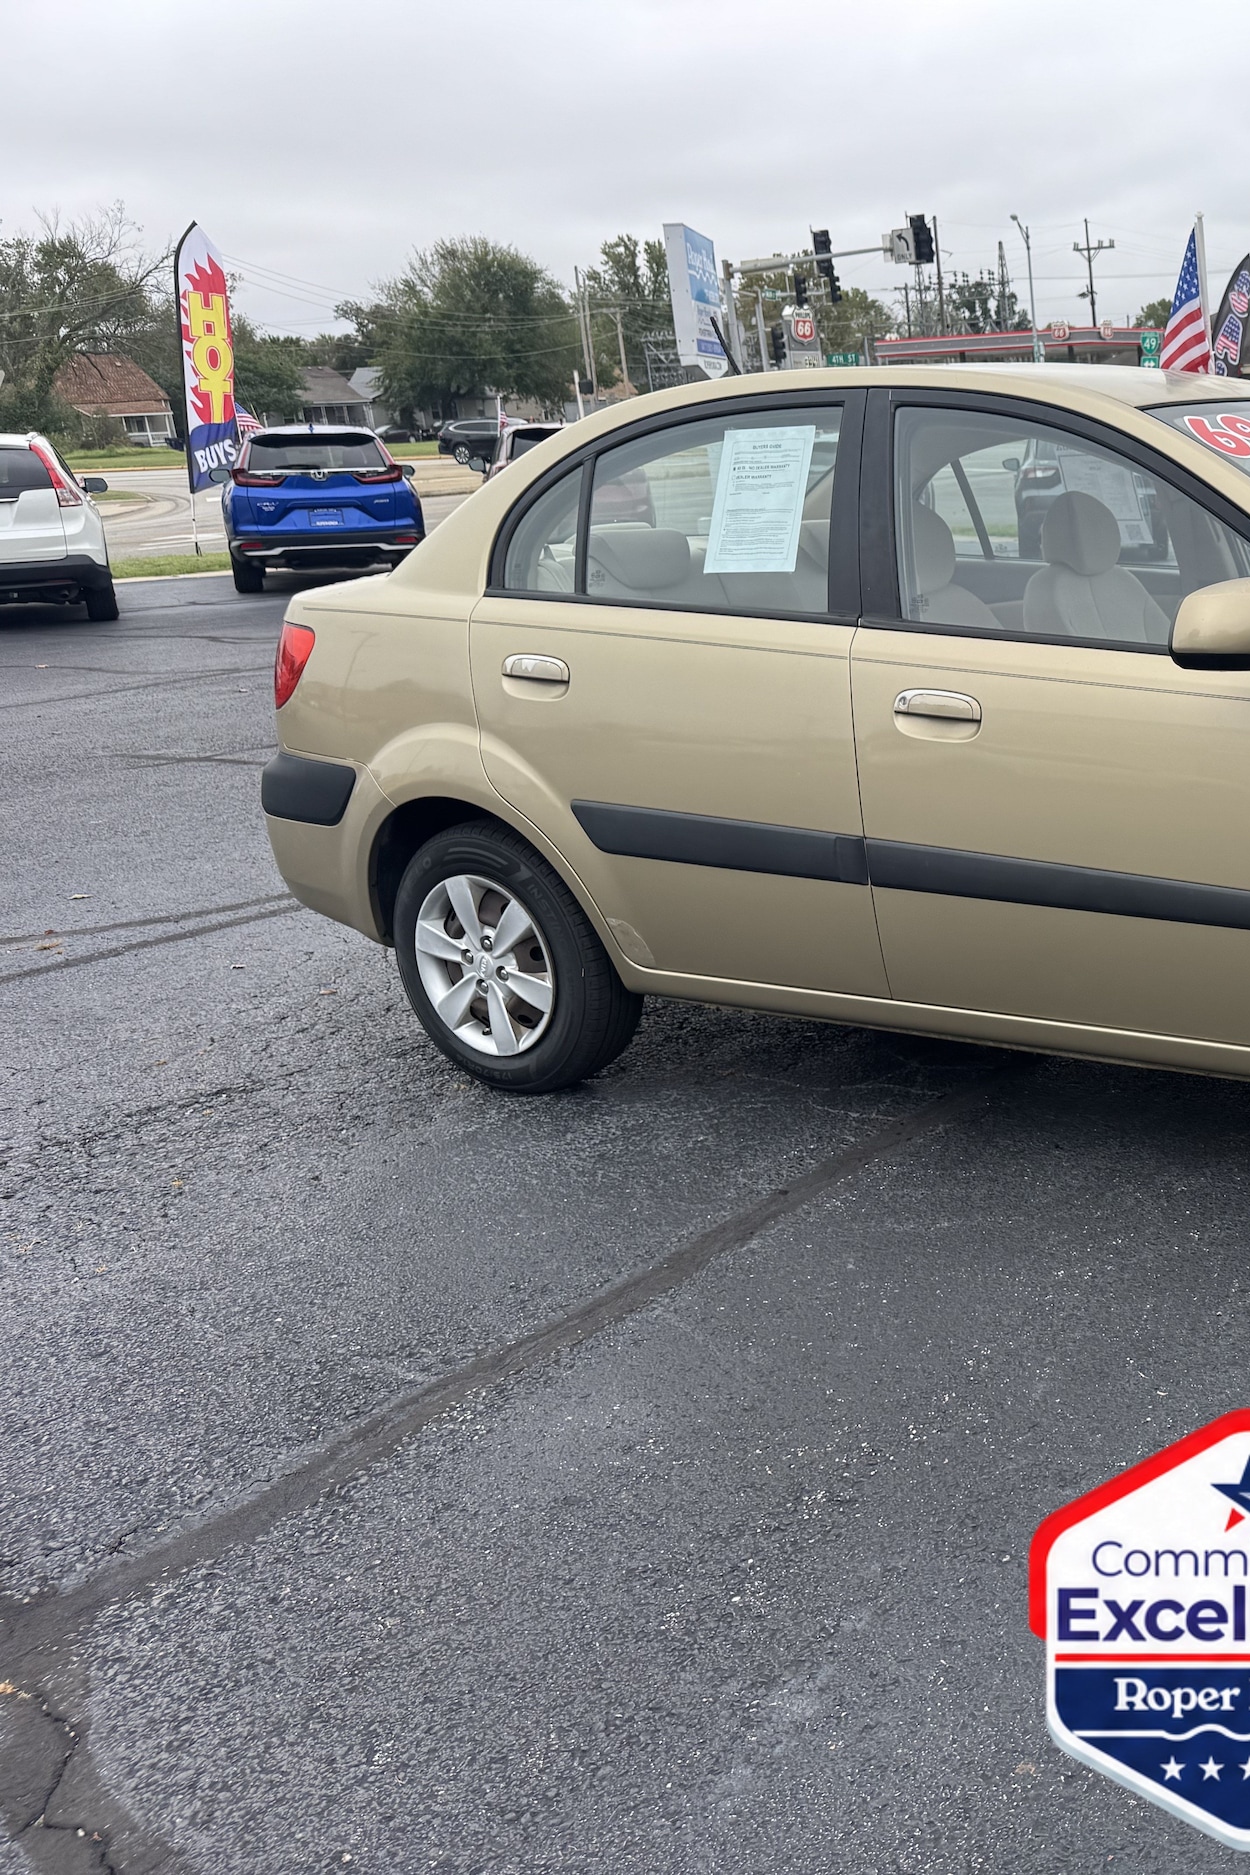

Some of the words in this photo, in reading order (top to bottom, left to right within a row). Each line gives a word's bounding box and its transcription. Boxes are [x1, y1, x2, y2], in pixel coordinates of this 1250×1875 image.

[897, 252, 912, 260] ONLY
[797, 321, 811, 336] 66
[1054, 328, 1065, 338] 66
[1143, 337, 1157, 350] 49
[188, 290, 234, 424] HOT
[832, 355, 844, 363] 4TH
[848, 353, 856, 363] ST
[194, 438, 237, 473] BUYS
